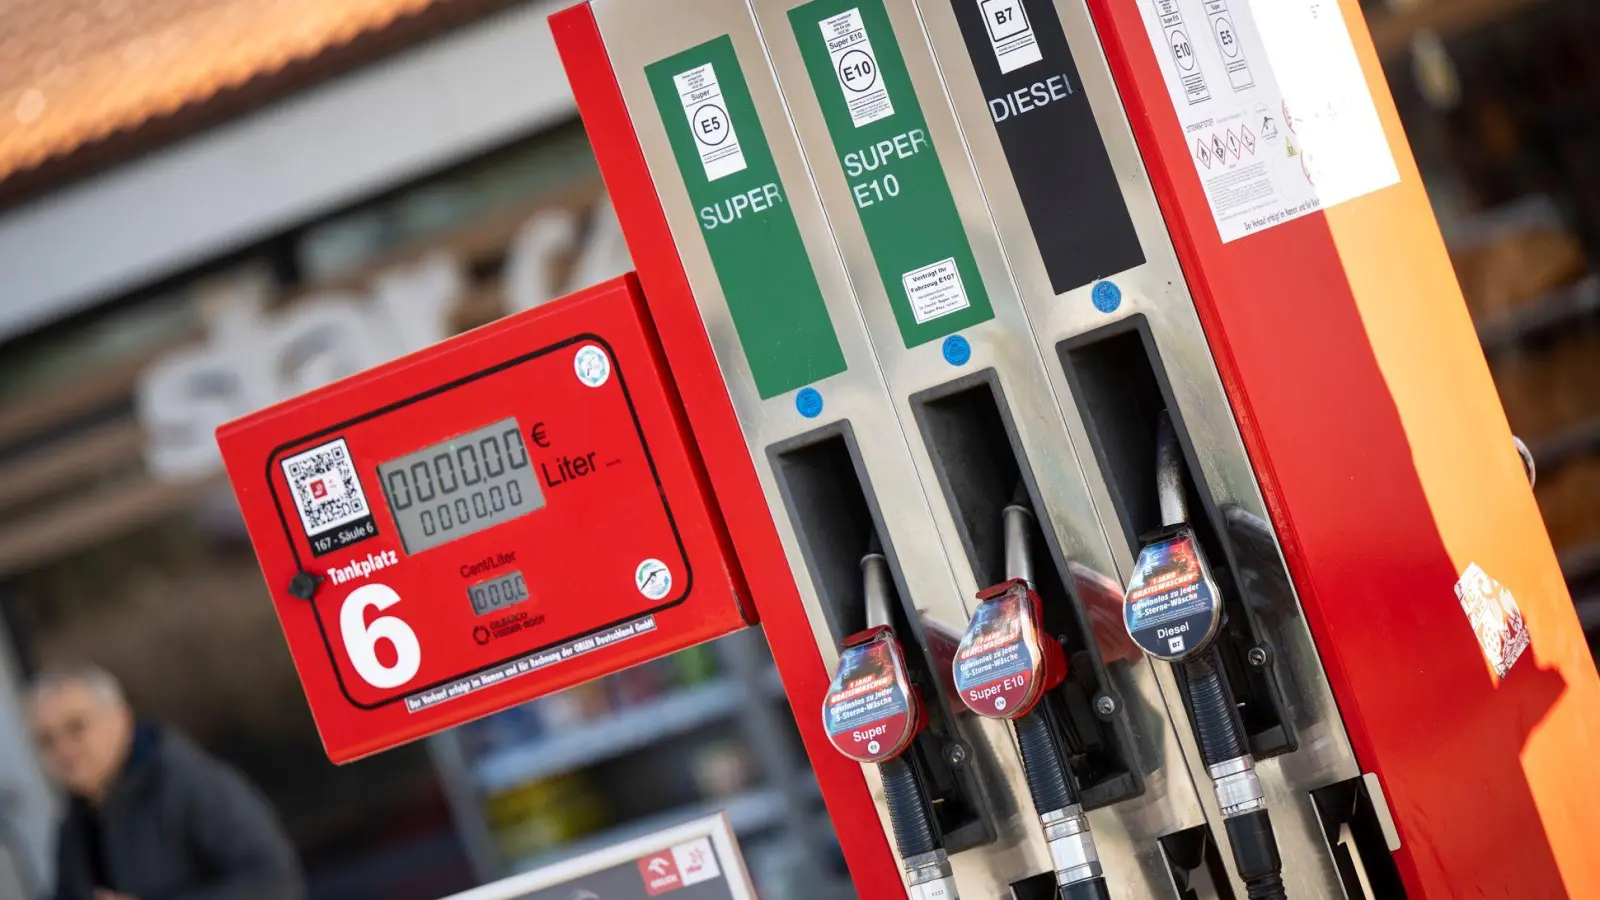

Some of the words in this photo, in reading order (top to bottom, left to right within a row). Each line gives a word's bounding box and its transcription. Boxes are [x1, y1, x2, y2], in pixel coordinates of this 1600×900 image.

[994, 7, 1013, 25] B7
[829, 38, 849, 50] Super
[850, 32, 863, 43] E10
[1174, 42, 1191, 59] E10
[1220, 30, 1233, 45] E5
[843, 61, 871, 82] E10
[691, 90, 710, 101] Super
[701, 116, 720, 134] E5
[844, 129, 929, 177] SUPER
[853, 174, 900, 208] E10
[700, 183, 782, 230] SUPER
[911, 280, 938, 293] Fahrzeug
[938, 273, 955, 283] E10?
[912, 270, 937, 282] Verträgt
[531, 422, 550, 448] €
[541, 451, 596, 487] Liter
[314, 537, 331, 552] 167
[337, 526, 365, 544] Säule
[365, 522, 374, 534] 6
[327, 550, 399, 586] Tankplatz
[460, 551, 516, 578] Cent/Liter
[1132, 594, 1169, 611] Gewinnlos
[1180, 583, 1199, 596] jeder
[1137, 593, 1198, 618] 5-Sterne-Wäsche
[340, 583, 421, 689] 6
[1157, 621, 1189, 639] Diesel
[409, 699, 421, 710] Der
[421, 690, 447, 704] Verkauf
[448, 681, 471, 696] erfolgt
[471, 679, 480, 688] im
[480, 671, 504, 685] Namen
[505, 664, 518, 676] und
[518, 660, 529, 672] für
[529, 651, 561, 668] Rechnung
[561, 647, 573, 657] der
[573, 638, 595, 653] ORLEN
[595, 625, 634, 645] Deutschland
[634, 618, 654, 632] GmbH
[960, 654, 992, 671] Gewinnlos
[993, 651, 1001, 659] zu
[1001, 644, 1019, 657] jeder
[965, 653, 1018, 679] 5-Sterne-Wäsche
[830, 697, 865, 715] Gewinnlos
[866, 694, 874, 702] zu
[874, 687, 894, 701] jeder
[970, 683, 1001, 702] Super
[1004, 675, 1024, 691] E10
[836, 696, 892, 722] 5-Sterne-Wäsche
[853, 724, 887, 742] Super
